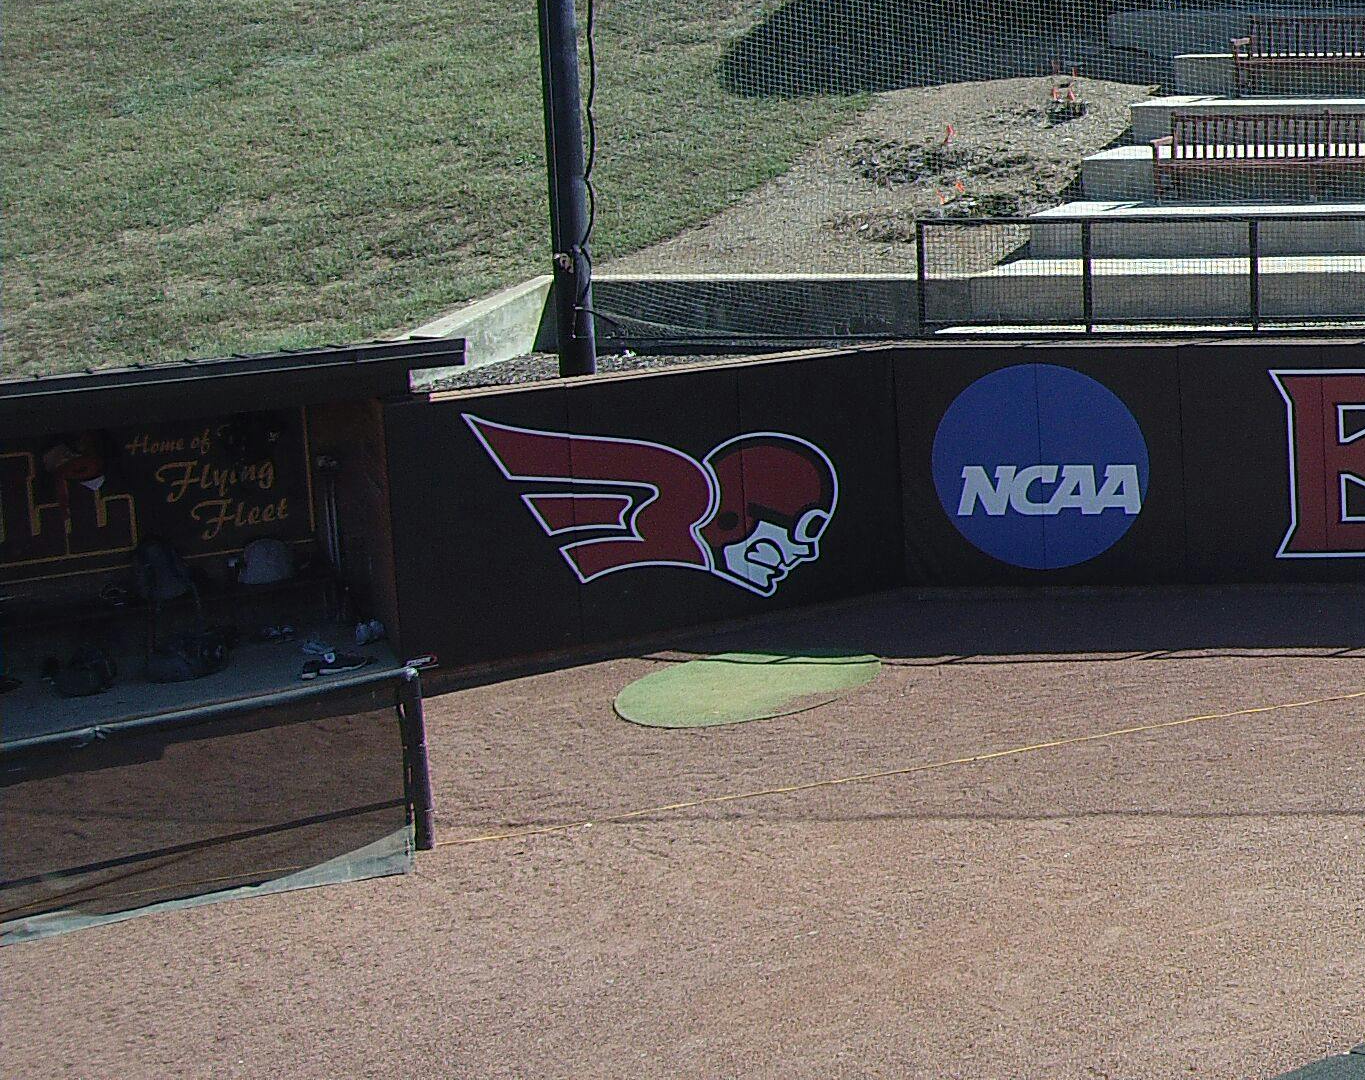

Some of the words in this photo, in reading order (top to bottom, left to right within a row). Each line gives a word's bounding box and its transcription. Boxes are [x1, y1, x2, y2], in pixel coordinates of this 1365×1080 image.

[125, 431, 185, 455] Home
[191, 427, 213, 455] of
[154, 457, 275, 503] Flying
[957, 464, 1142, 516] NCAA
[191, 496, 289, 540] Fleet
